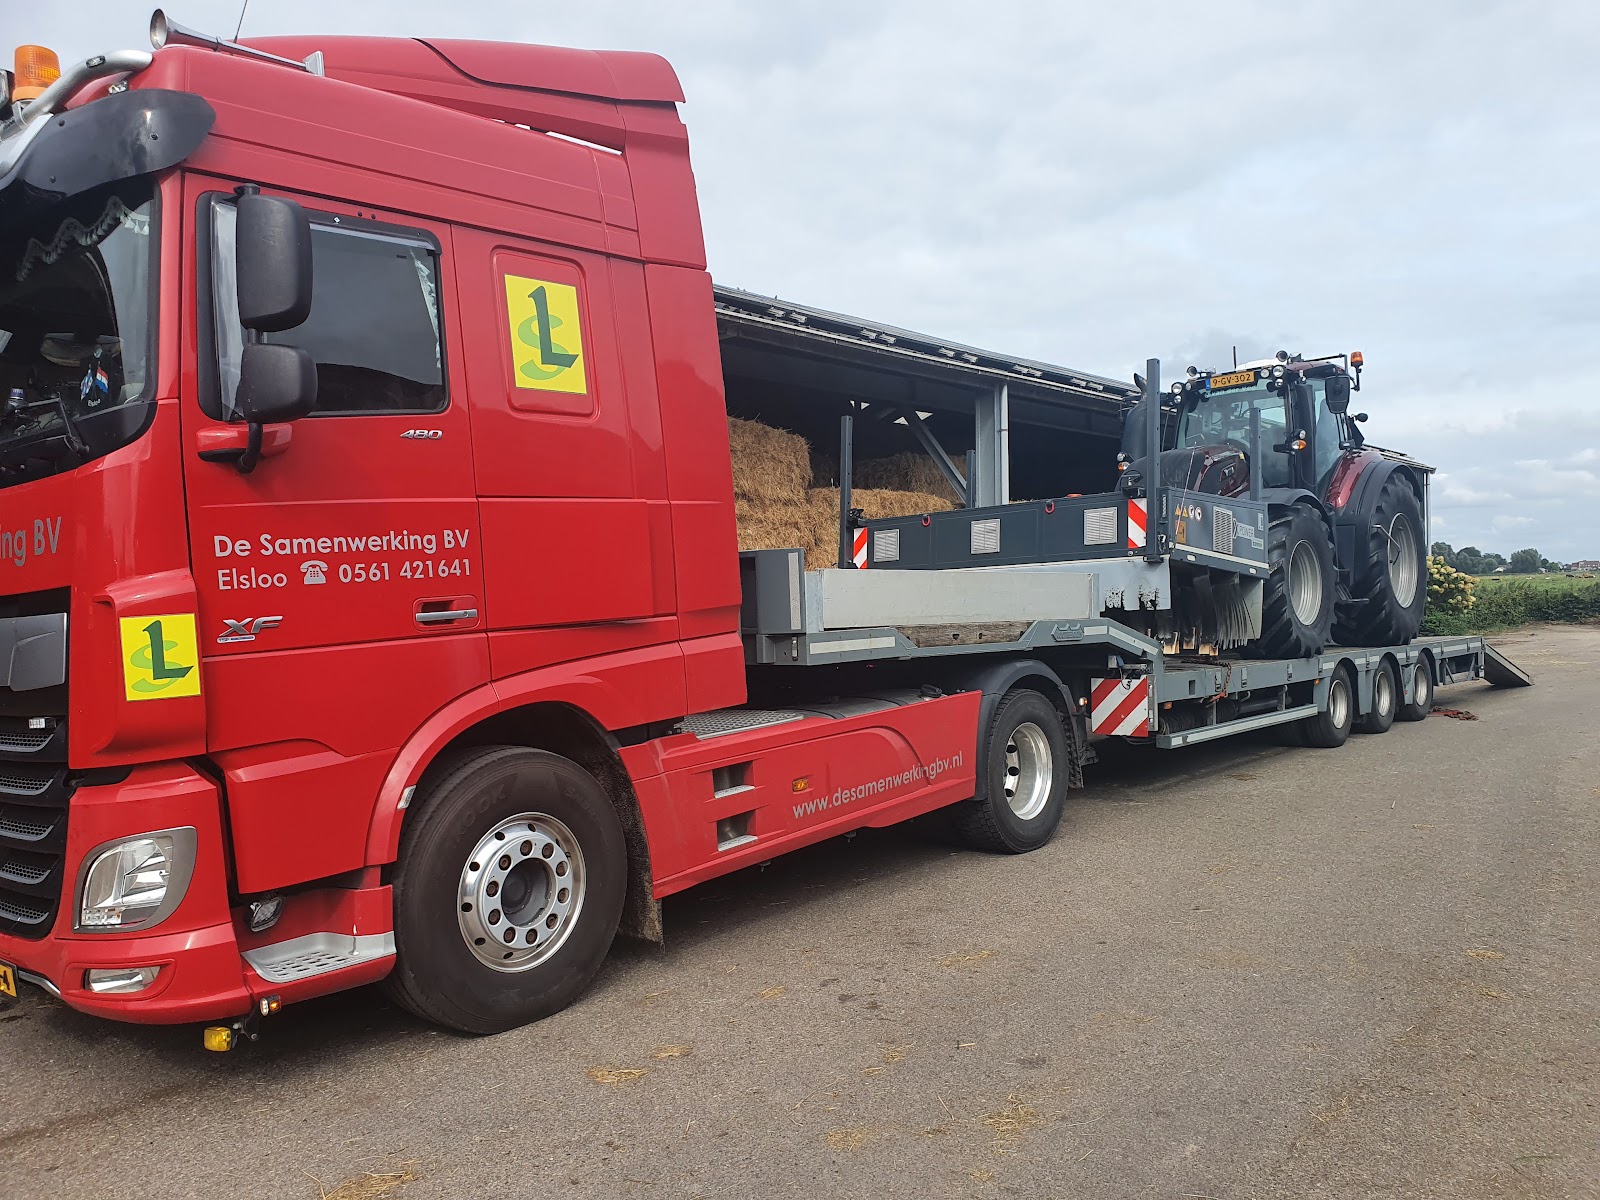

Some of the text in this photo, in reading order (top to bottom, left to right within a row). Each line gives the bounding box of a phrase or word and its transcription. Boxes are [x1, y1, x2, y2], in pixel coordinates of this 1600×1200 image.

[1212, 373, 1251, 387] 9-GV-302
[399, 429, 443, 439] 480
[34, 516, 62, 556] BV
[213, 529, 470, 557] De Samenwerking BV
[217, 558, 470, 590] Elsloo 0561 421641
[218, 615, 284, 637] XF
[792, 750, 963, 820] www.desamenwerkingbv.nl
